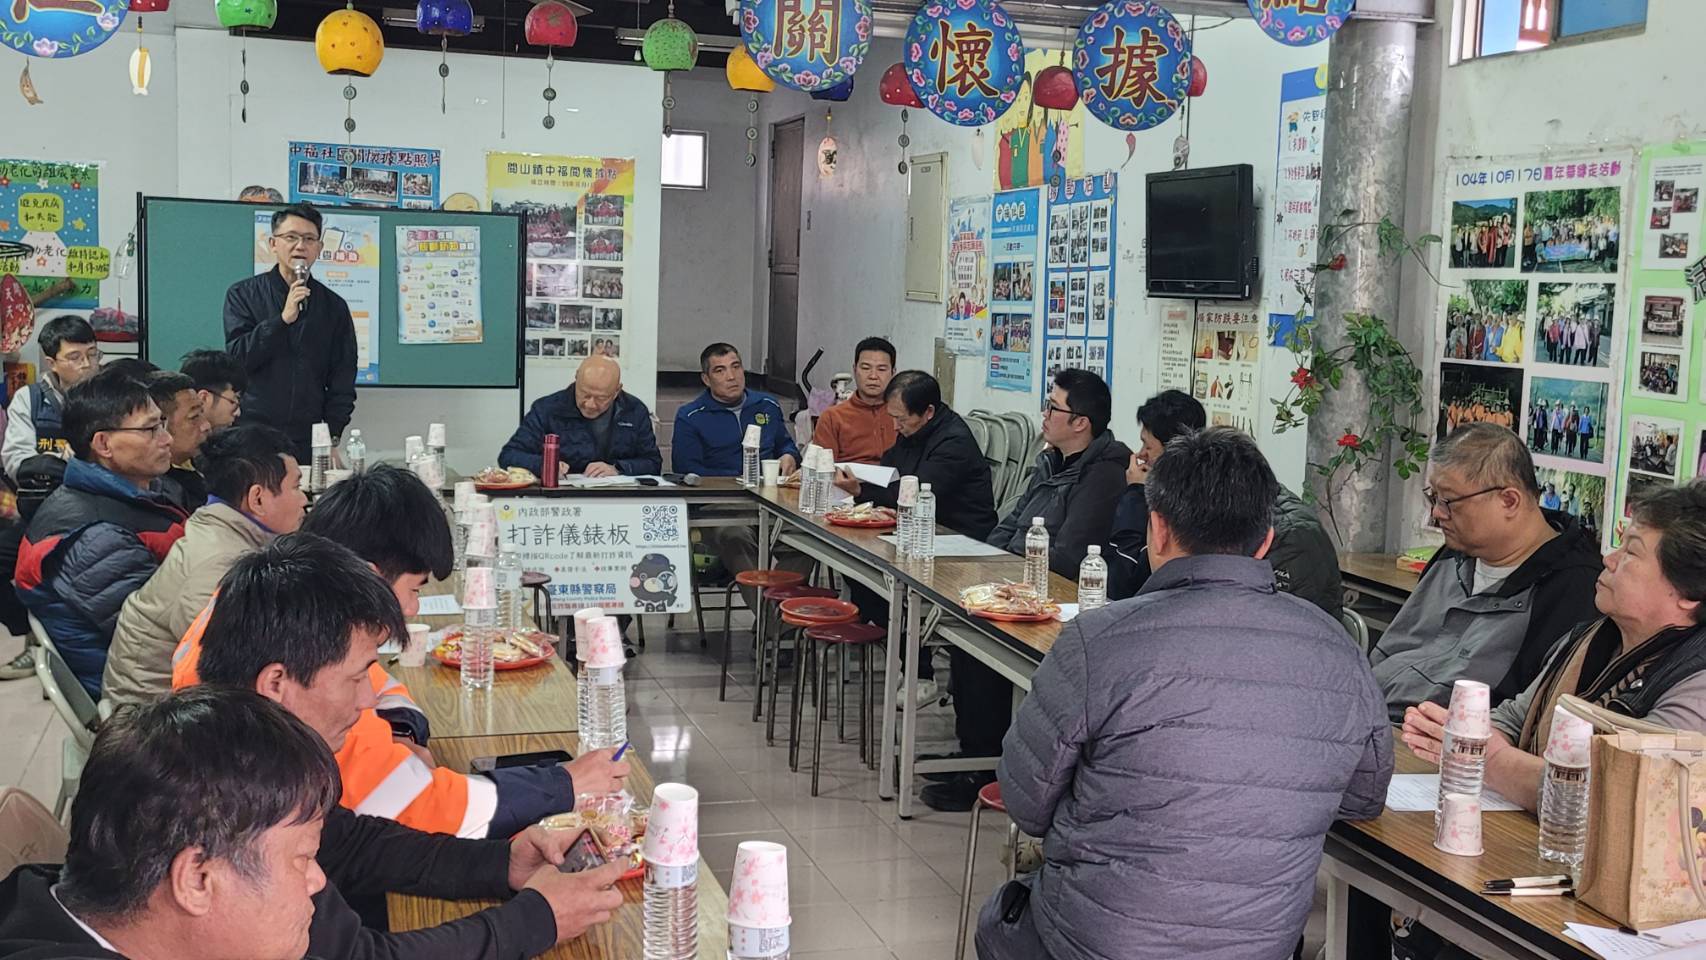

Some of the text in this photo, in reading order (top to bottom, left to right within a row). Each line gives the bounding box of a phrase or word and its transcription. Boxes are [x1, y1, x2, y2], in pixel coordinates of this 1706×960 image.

[772, 0, 841, 66] 關
[930, 19, 1000, 97] 懷
[1099, 26, 1170, 108] 據
[518, 506, 582, 518] 內政部警政署
[507, 523, 631, 547] 打詐儀錶板
[547, 583, 616, 596] 臺東縣警察局
